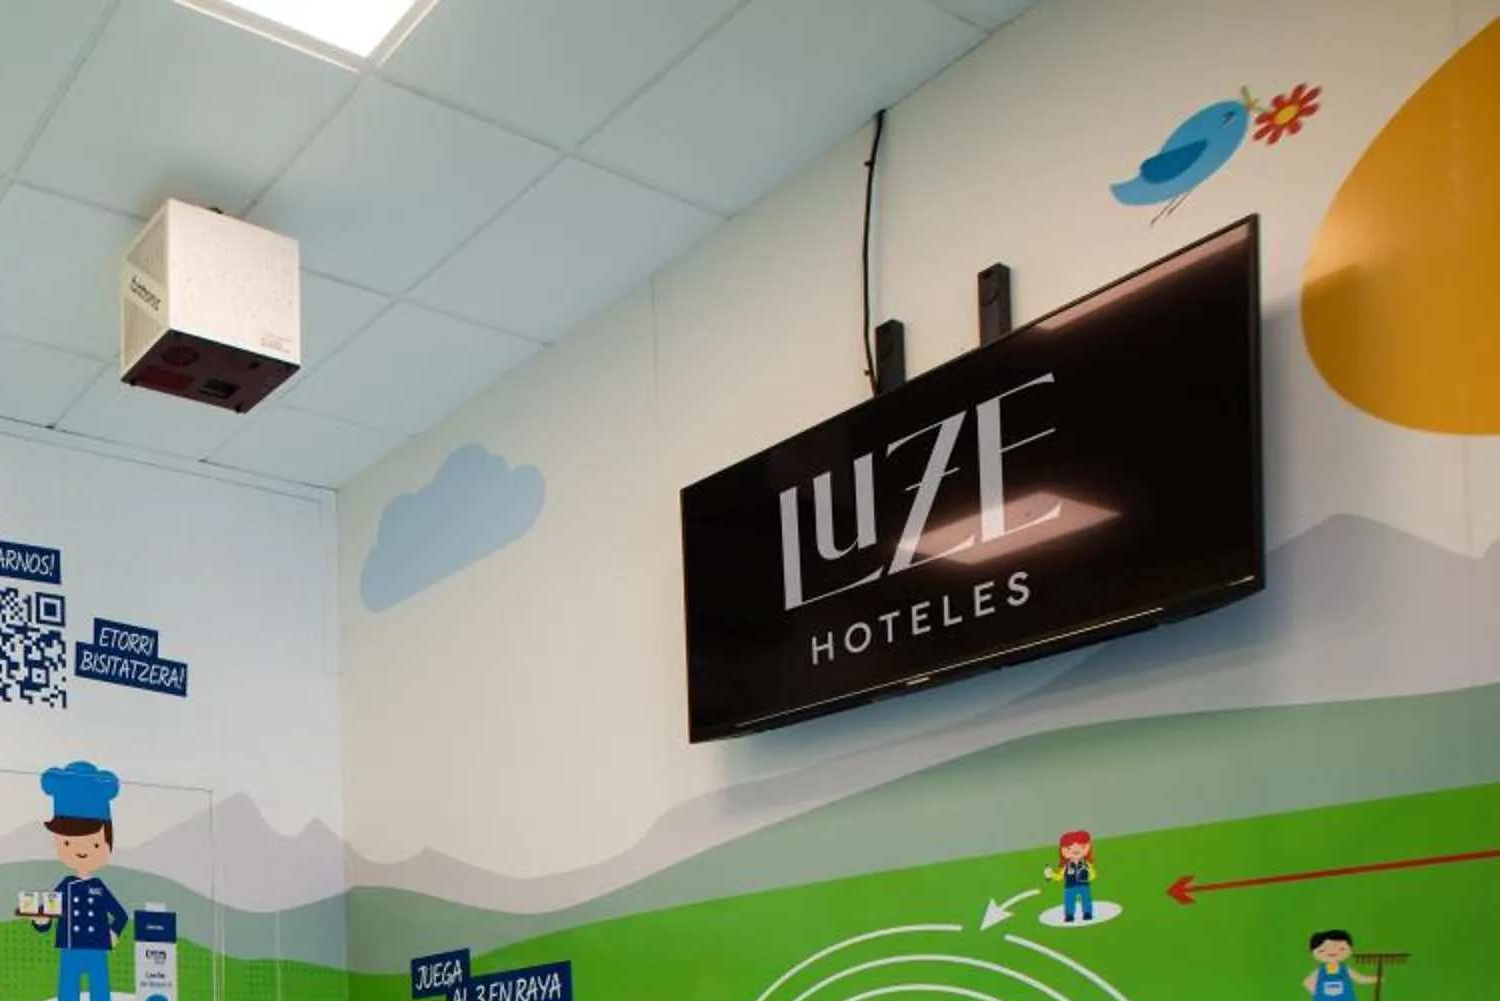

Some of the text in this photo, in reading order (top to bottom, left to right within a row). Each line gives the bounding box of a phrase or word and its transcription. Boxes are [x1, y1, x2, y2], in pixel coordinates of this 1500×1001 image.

[811, 571, 1032, 665] HOTELES
[100, 627, 155, 657] ETORRI
[80, 651, 185, 689] BISITATZERA!
[415, 959, 464, 991] JUEGA
